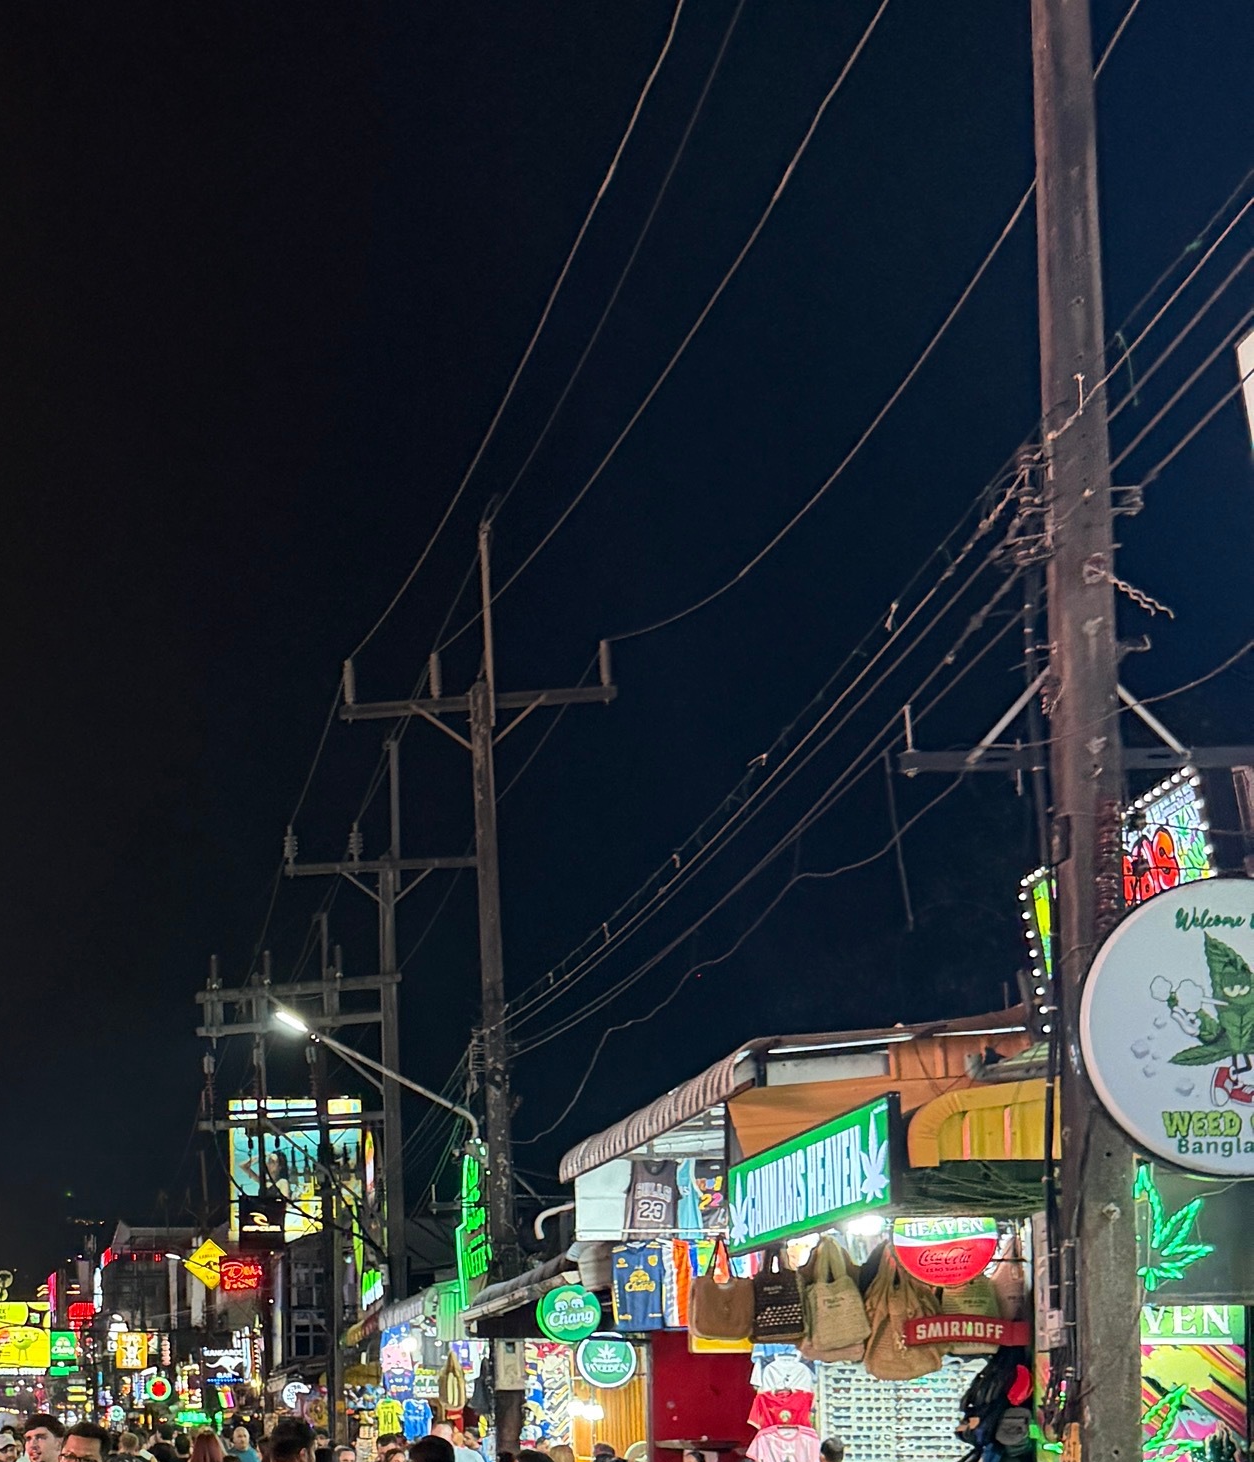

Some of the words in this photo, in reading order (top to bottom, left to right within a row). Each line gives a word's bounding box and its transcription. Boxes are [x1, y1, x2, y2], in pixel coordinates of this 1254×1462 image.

[1175, 906, 1246, 932] Welcome
[1161, 1110, 1243, 1138] WEED
[747, 1149, 806, 1238] CANNABIS
[806, 1124, 863, 1218] HEAVEN
[635, 1182, 672, 1203] BULLS
[639, 1200, 666, 1222] 23
[904, 1217, 985, 1237] HEAVEN
[548, 1310, 594, 1327] Chang
[916, 1321, 1004, 1340] SMIRNOFF
